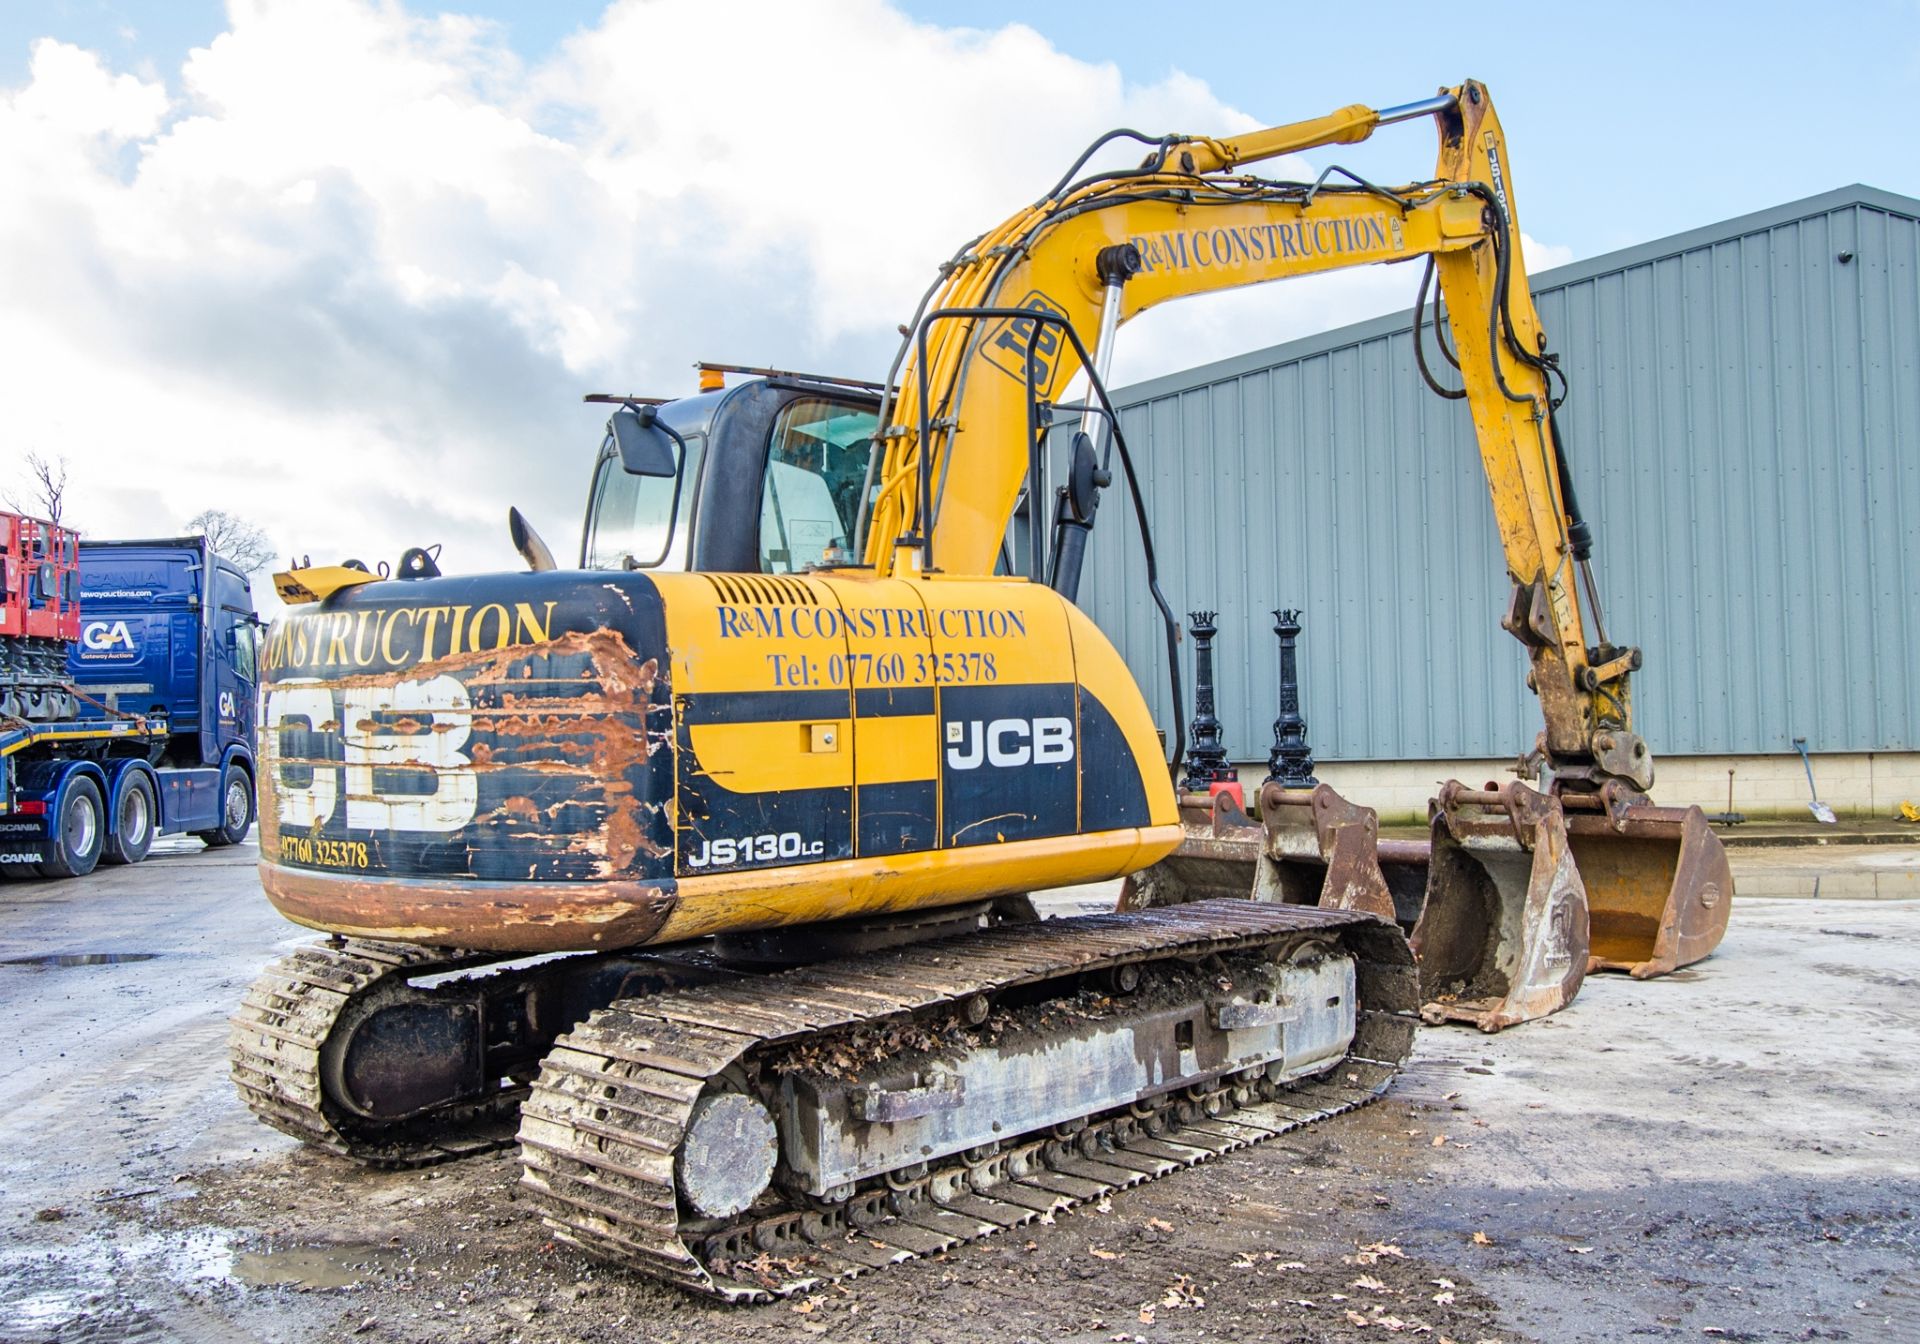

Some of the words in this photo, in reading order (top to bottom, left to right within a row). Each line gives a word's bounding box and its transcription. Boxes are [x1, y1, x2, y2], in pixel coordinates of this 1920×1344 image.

[1130, 232, 1188, 273] R&M
[1191, 216, 1387, 267] CONSTRUCTION
[83, 621, 135, 650] GA
[716, 606, 785, 639] R&M
[791, 607, 1027, 639] CONSTRUCTION
[767, 654, 820, 687] Tel:
[828, 652, 905, 686] 07760
[914, 652, 997, 684] 325378
[219, 692, 236, 717] GA
[946, 717, 1075, 770] JCB
[281, 836, 313, 863] 07760
[316, 840, 368, 868] 325378
